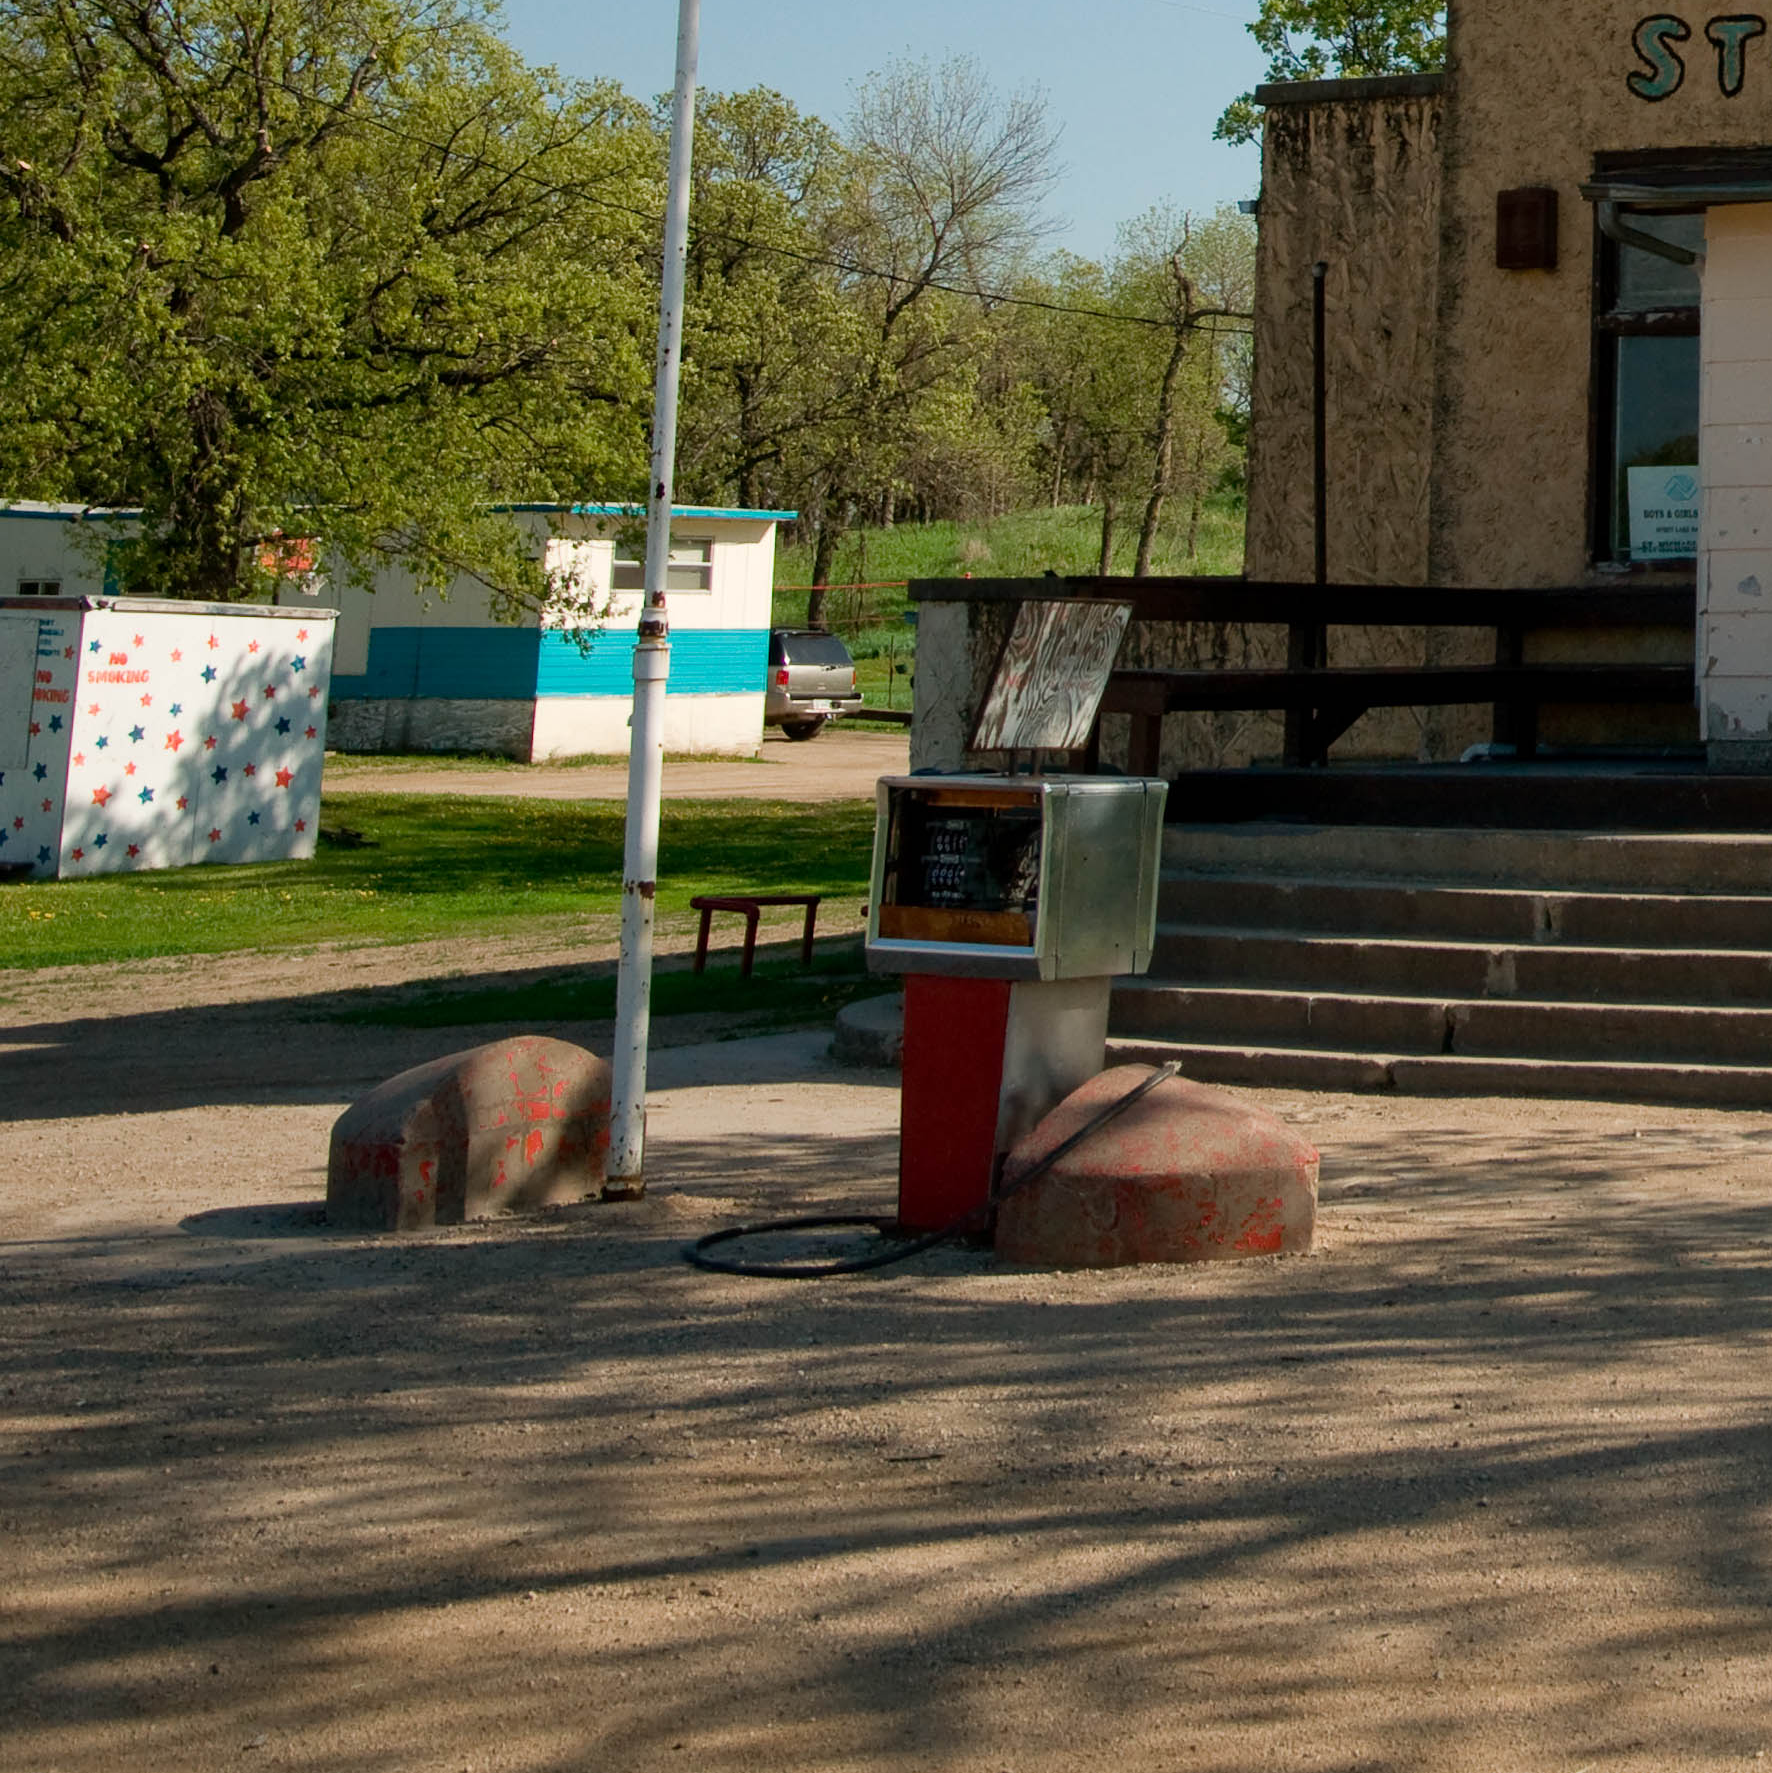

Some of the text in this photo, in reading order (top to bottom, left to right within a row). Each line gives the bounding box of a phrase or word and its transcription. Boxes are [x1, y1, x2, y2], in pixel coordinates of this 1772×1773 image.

[109, 652, 128, 666] NO
[37, 670, 53, 684] NO
[87, 670, 151, 684] SMOKING
